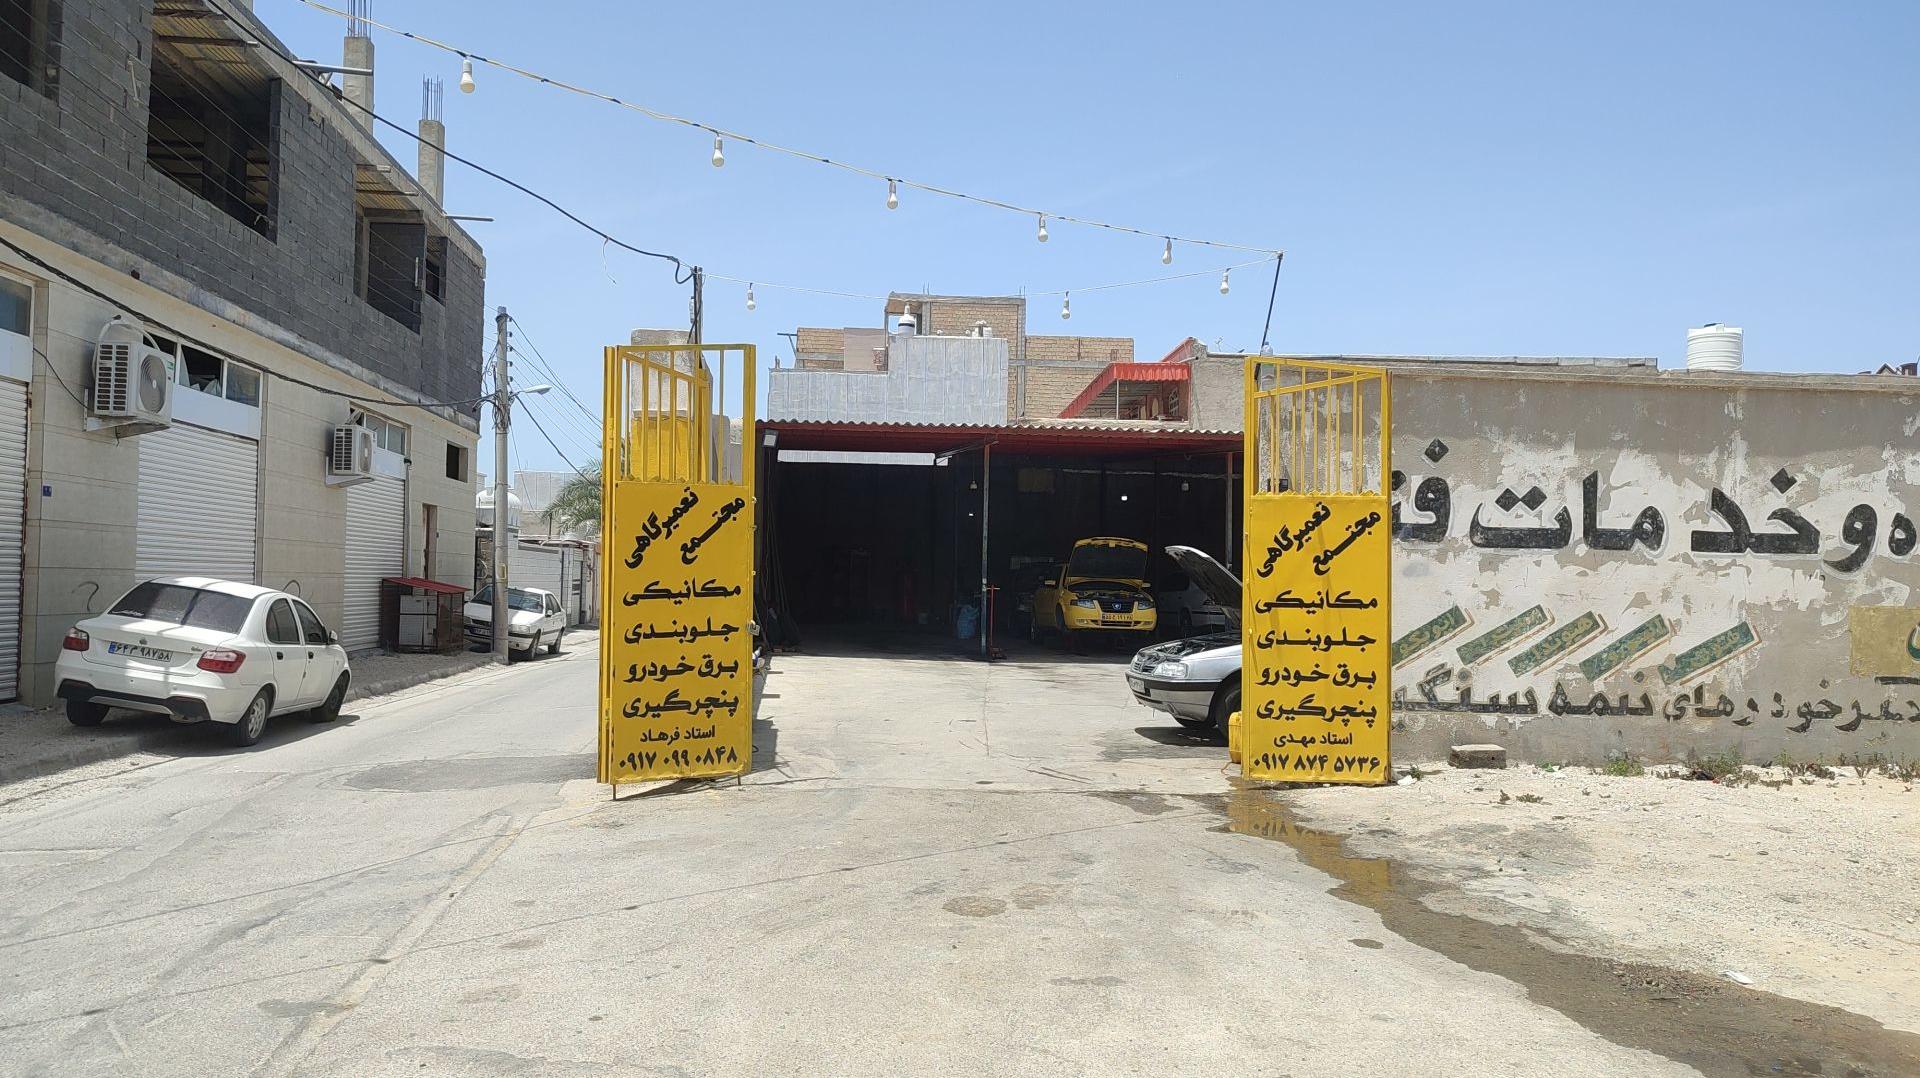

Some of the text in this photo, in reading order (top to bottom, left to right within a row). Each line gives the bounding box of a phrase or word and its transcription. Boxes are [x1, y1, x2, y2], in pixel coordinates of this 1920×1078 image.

[1469, 467, 1820, 554] خدمات
[625, 487, 699, 569] تعمیرگاهی
[680, 497, 745, 565] مجتمع
[1257, 502, 1331, 578] تعمیرگاهی
[1312, 511, 1381, 576] مجتمع
[623, 577, 741, 606] مکانیکی
[1255, 590, 1378, 615] مکانیکی
[624, 616, 739, 644] جلوبندی
[1257, 627, 1376, 652] جلوبندی
[624, 654, 739, 683] برق خودرو
[1257, 664, 1376, 689] برق خودرو
[623, 689, 739, 719] پنچرگیری
[1257, 693, 1377, 728] پنچرگیری
[640, 725, 715, 745] استاد فرهاد
[1273, 732, 1353, 748] استاد مهدی
[619, 745, 738, 771] ۰۹۱۷ ۰۹۹ ۰۸۴۸
[1254, 752, 1380, 773] ۰۹۱۷ ۸۷۴ ۵۷۳۶
